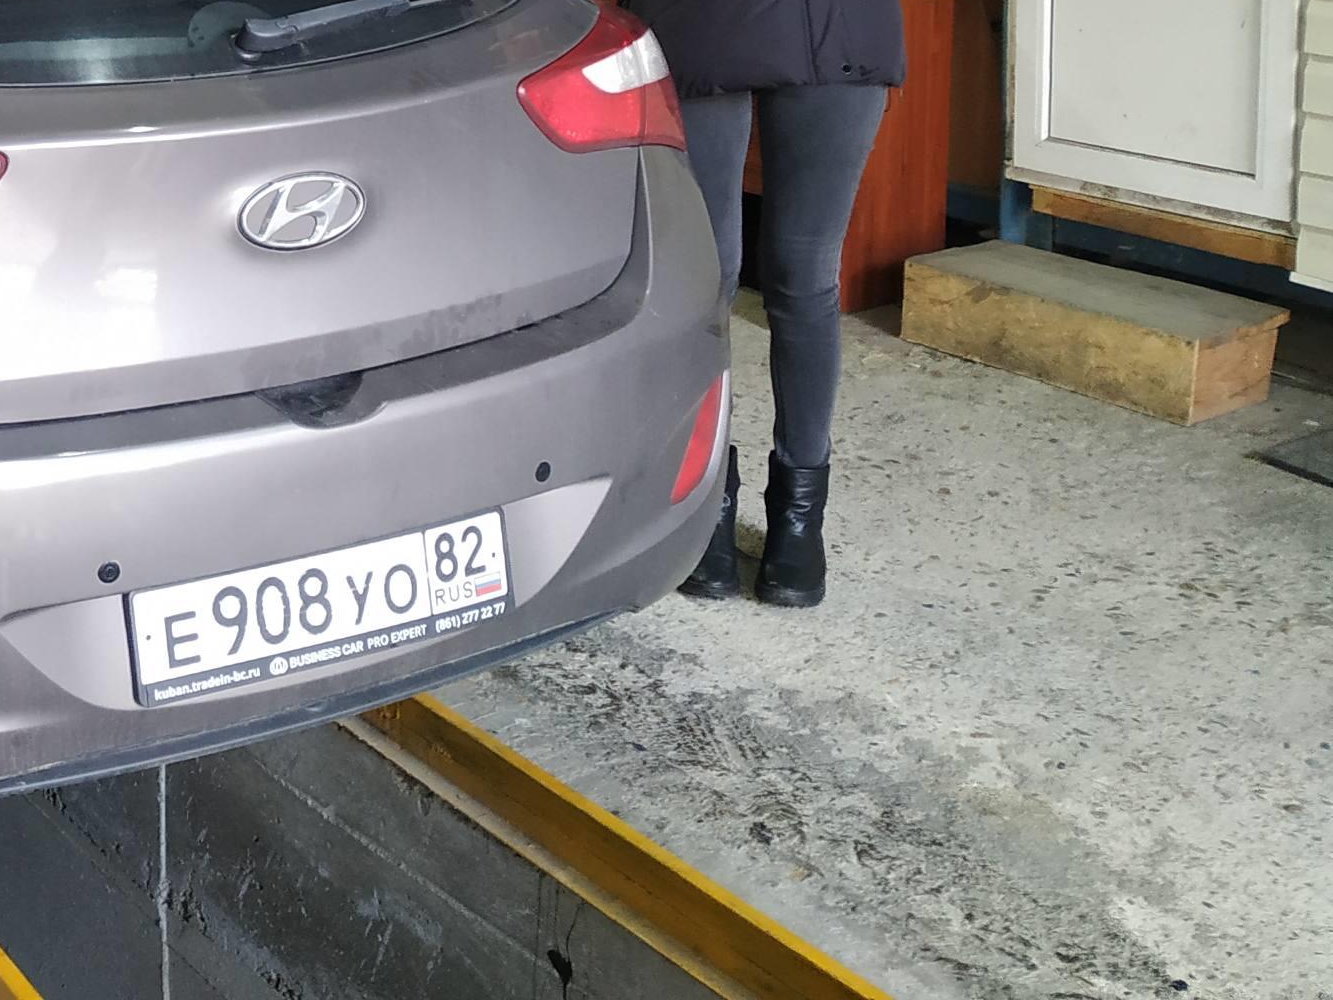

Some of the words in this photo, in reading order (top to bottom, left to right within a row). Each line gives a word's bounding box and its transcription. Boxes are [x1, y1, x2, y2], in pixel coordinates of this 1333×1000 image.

[434, 525, 486, 583] 82
[435, 581, 473, 606] RUS
[289, 645, 342, 669] BUSINESS
[342, 640, 364, 655] CAR
[367, 634, 388, 650] PRO
[391, 624, 427, 644] EXPERT
[435, 615, 461, 633] (861)
[462, 609, 479, 625] 277
[481, 604, 493, 619] 22
[494, 602, 506, 615] 77
[154, 667, 261, 701] kuban.tradein-bc.ru
